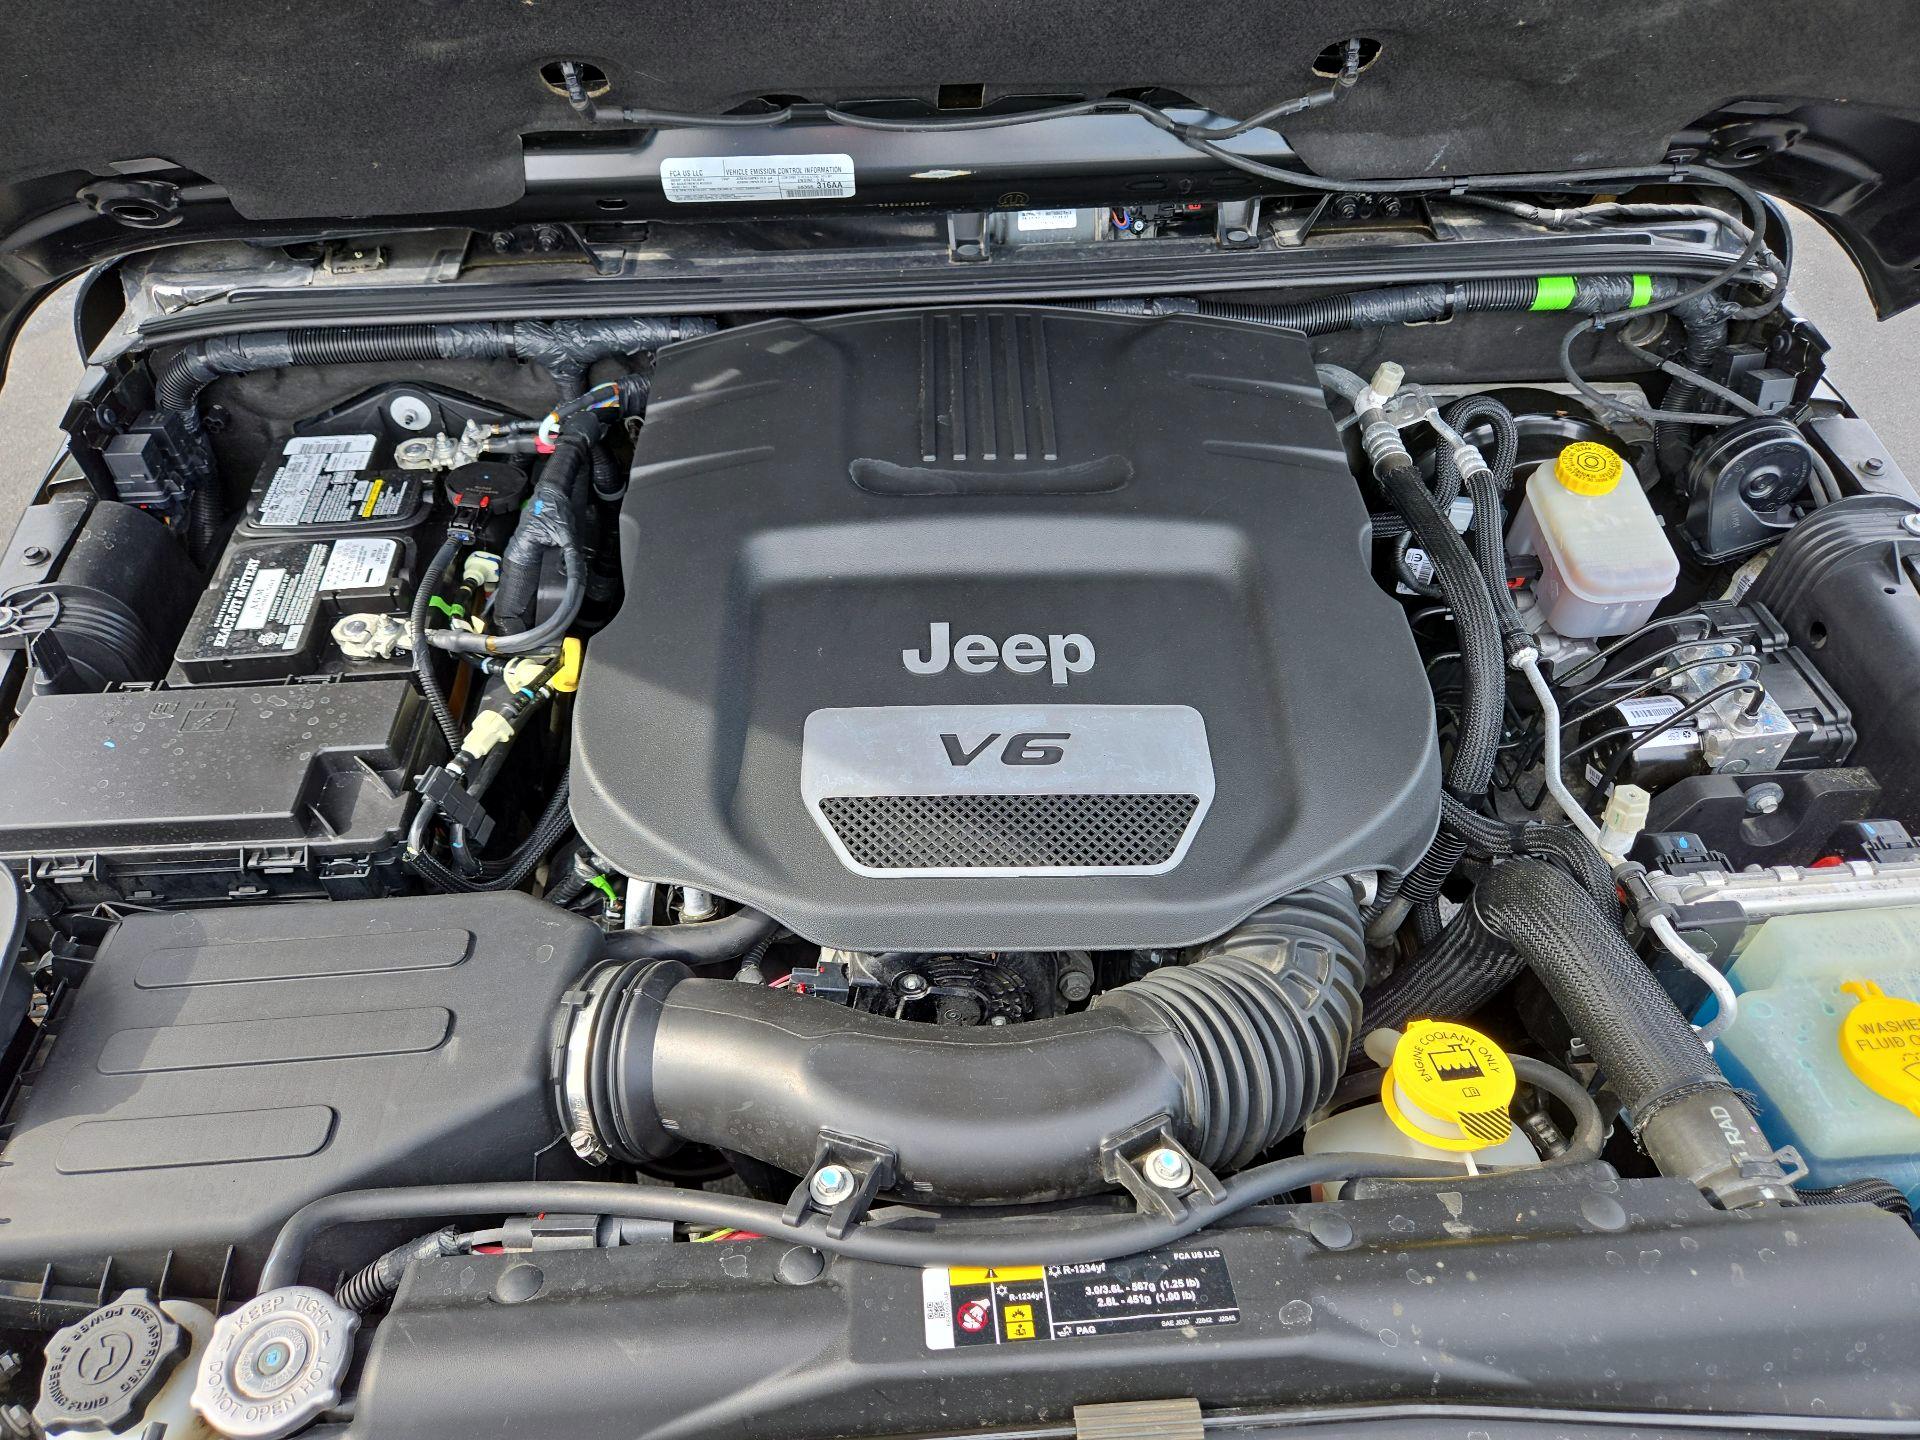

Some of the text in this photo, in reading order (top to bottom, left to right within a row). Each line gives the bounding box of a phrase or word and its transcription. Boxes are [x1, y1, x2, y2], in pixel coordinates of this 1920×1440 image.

[725, 168, 748, 176] VEHICLE
[750, 167, 777, 175] EMISSION
[778, 167, 801, 175] CONTROL
[233, 558, 260, 598] BATTERY
[902, 622, 1096, 686] Jeep
[940, 732, 1071, 766] V6
[1857, 1018, 1920, 1035] WASHE
[1413, 1031, 1501, 1083] ENGINE COOLANT ONLY
[1856, 1036, 1906, 1051] FLUID
[1710, 1105, 1746, 1145] RAD
[1173, 1252, 1192, 1260] FCA
[1204, 1250, 1221, 1258] LLC
[1062, 1262, 1106, 1278] R-1234yf
[1185, 1277, 1201, 1289] lb)
[235, 1294, 333, 1330] KEEP TIGHT
[1126, 1293, 1152, 1305] 451g
[1181, 1290, 1197, 1302] lb)
[1076, 1325, 1097, 1335] PAG
[48, 1307, 125, 1411] POWER STEERING FLUID
[120, 1307, 159, 1392] USE APPROVED
[208, 1360, 224, 1387] DO
[300, 1357, 330, 1395] HOT
[211, 1387, 243, 1418] NOT
[245, 1393, 297, 1421] OPEN
